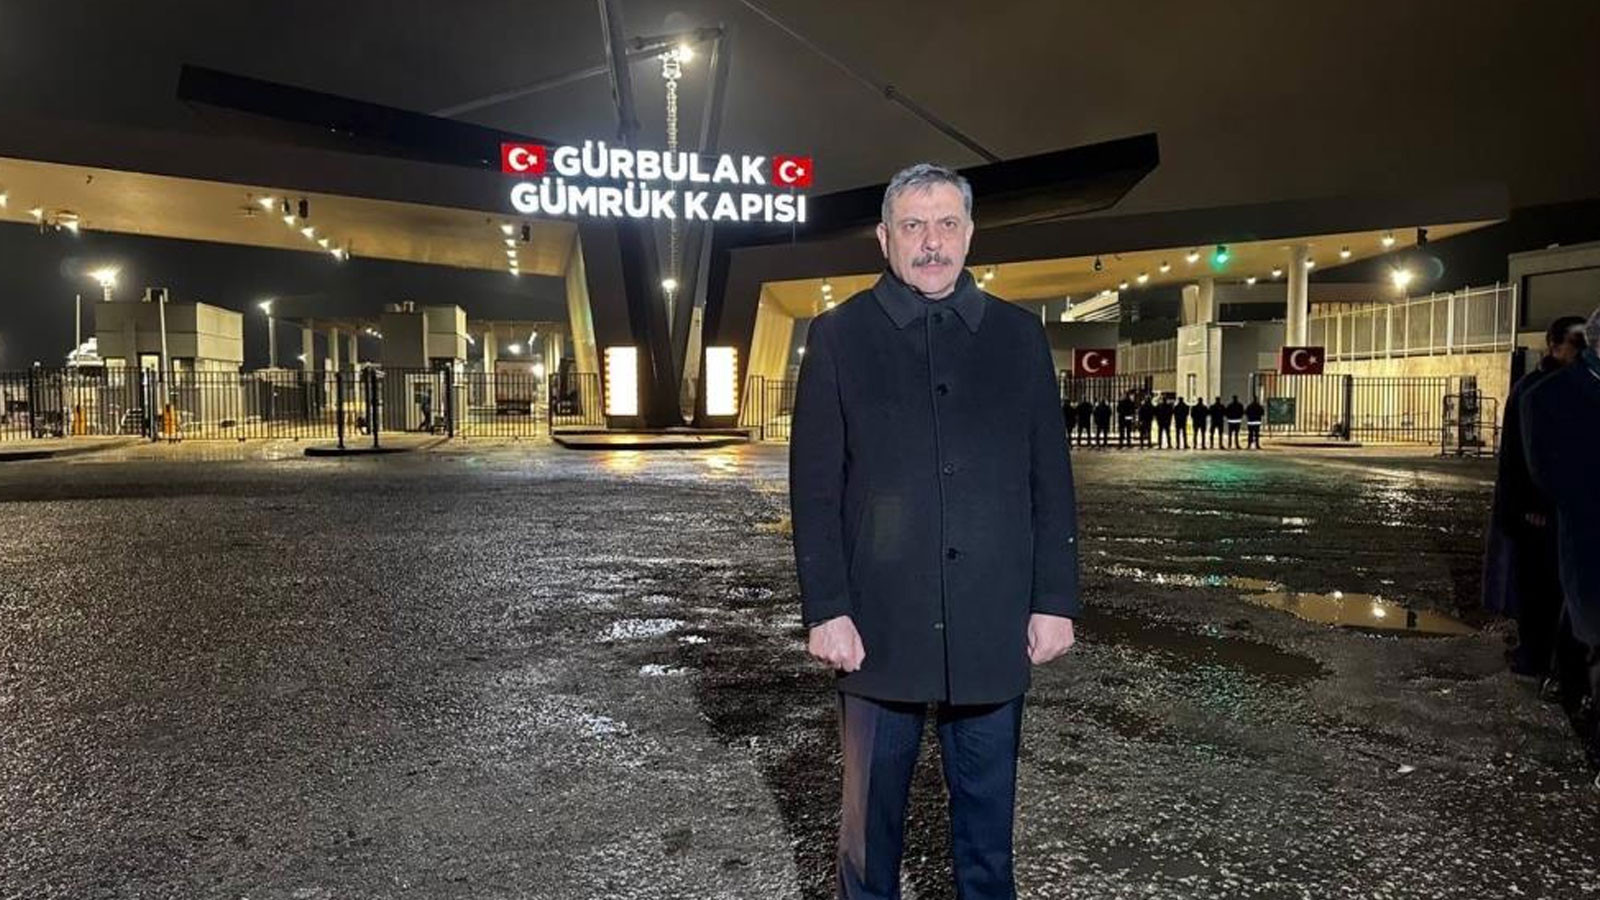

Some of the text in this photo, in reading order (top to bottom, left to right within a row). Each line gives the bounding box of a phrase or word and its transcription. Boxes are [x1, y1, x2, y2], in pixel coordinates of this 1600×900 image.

[553, 140, 766, 184] GÜRBULAK
[510, 177, 806, 223] GÜMRÜK KAPISI
